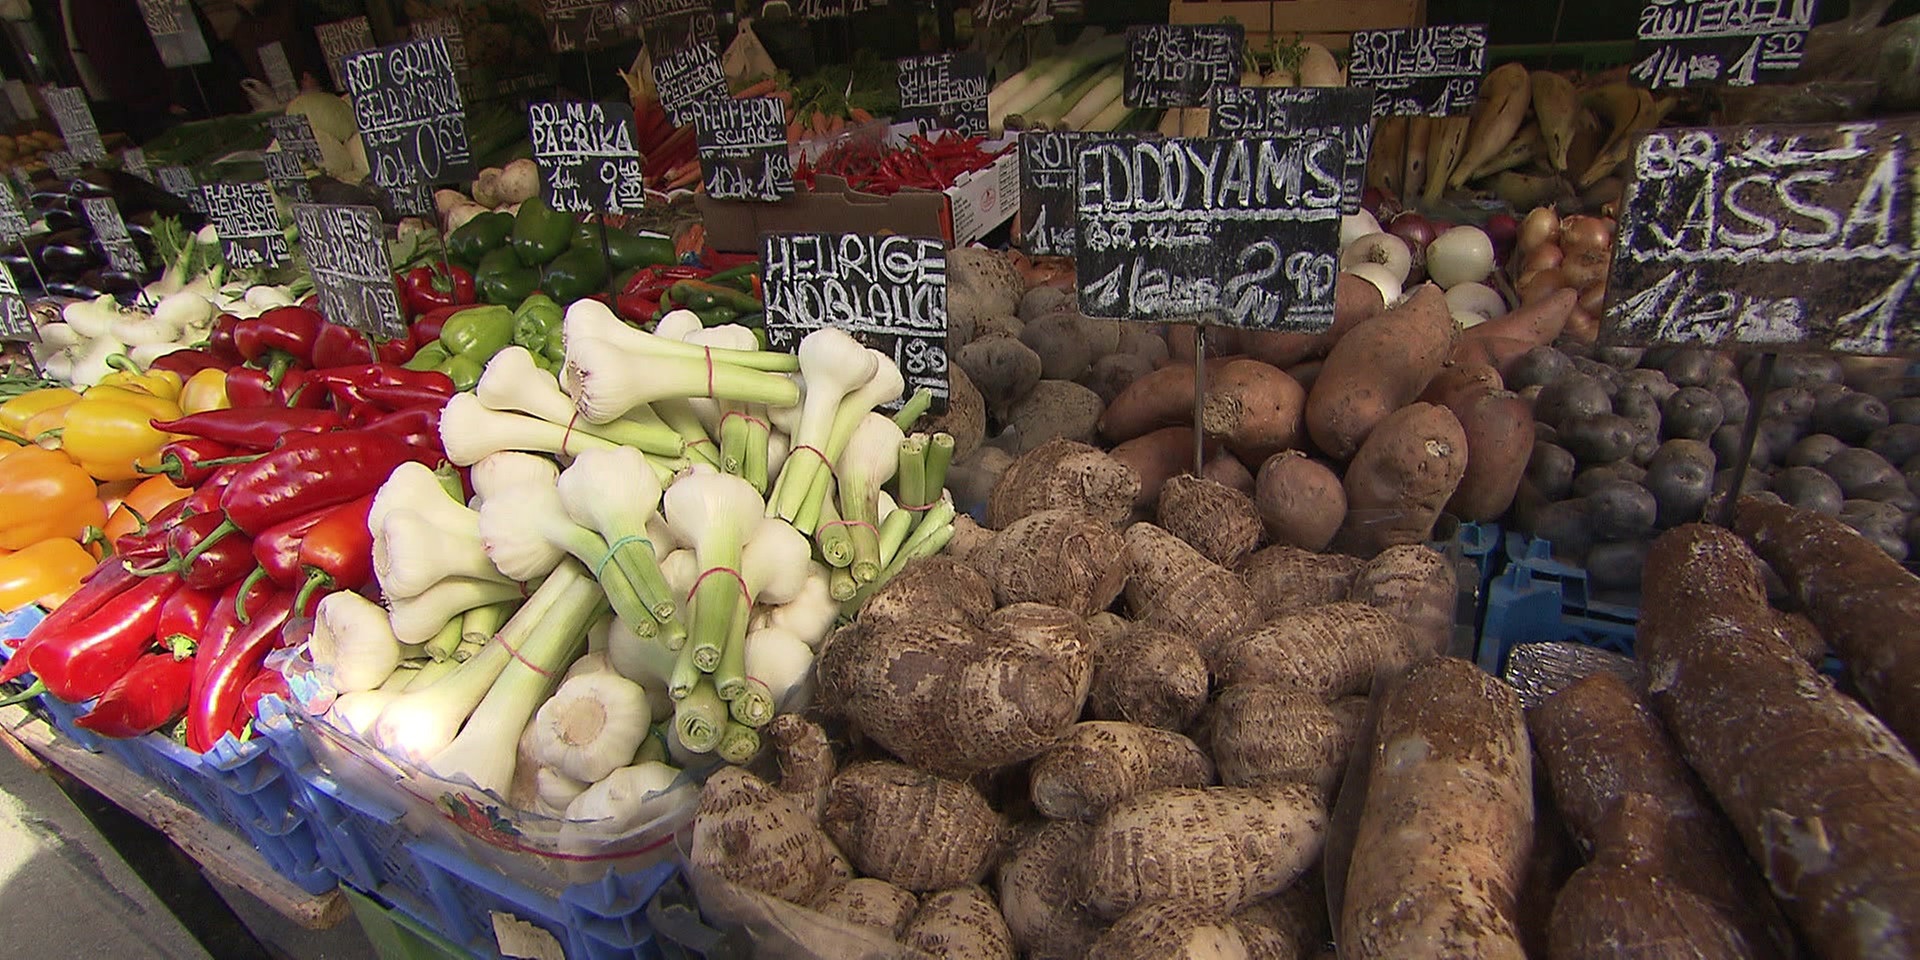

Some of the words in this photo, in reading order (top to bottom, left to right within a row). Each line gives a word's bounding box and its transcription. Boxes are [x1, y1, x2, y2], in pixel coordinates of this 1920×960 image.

[1353, 30, 1405, 53] ROT
[346, 52, 383, 96] ROT
[530, 103, 604, 125] DOLMA
[692, 97, 786, 136] PFEFFERONI
[532, 120, 634, 153] PAPRIKA
[1078, 137, 1342, 213] EDDOYAMS
[207, 193, 275, 217] HEURIGE
[766, 233, 946, 285] HEURIGE
[762, 277, 947, 330] KNOBLAUCH
